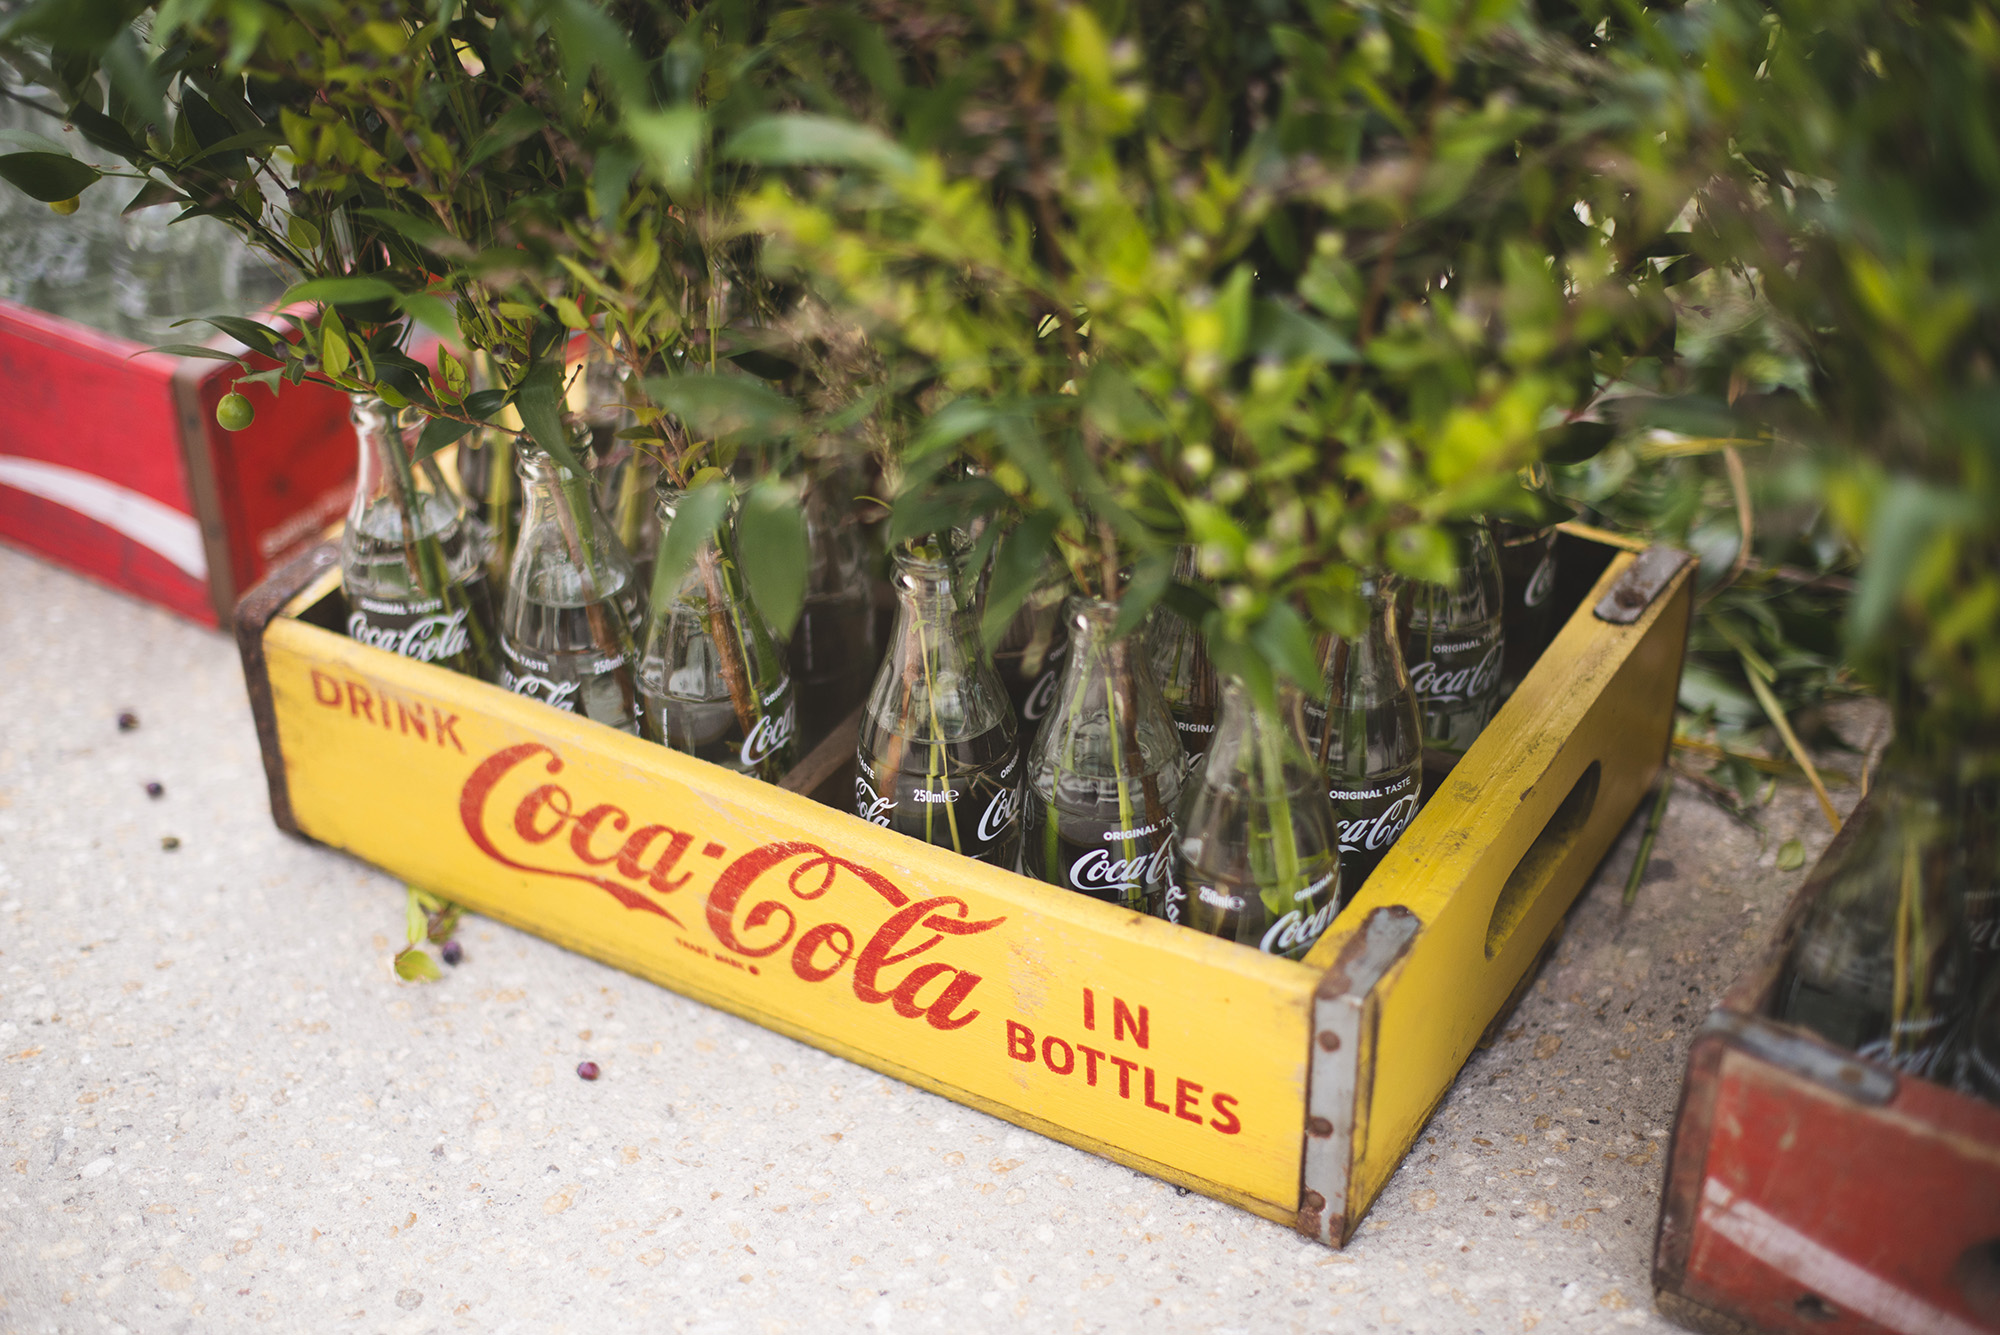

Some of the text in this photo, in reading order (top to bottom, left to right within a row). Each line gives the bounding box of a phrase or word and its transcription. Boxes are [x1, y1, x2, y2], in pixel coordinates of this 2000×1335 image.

[348, 607, 471, 663] Coca-Cola
[1433, 639, 1480, 654] ORIGINAL
[519, 656, 549, 673] TASTE
[311, 670, 466, 755] DRINK
[1329, 776, 1411, 799] ORIGINAL TASTE
[1103, 824, 1158, 841] ORIGINAL
[459, 742, 1008, 1031] Coca-Cola
[1083, 987, 1149, 1049] IN
[1006, 1019, 1241, 1135] BOTTLES
